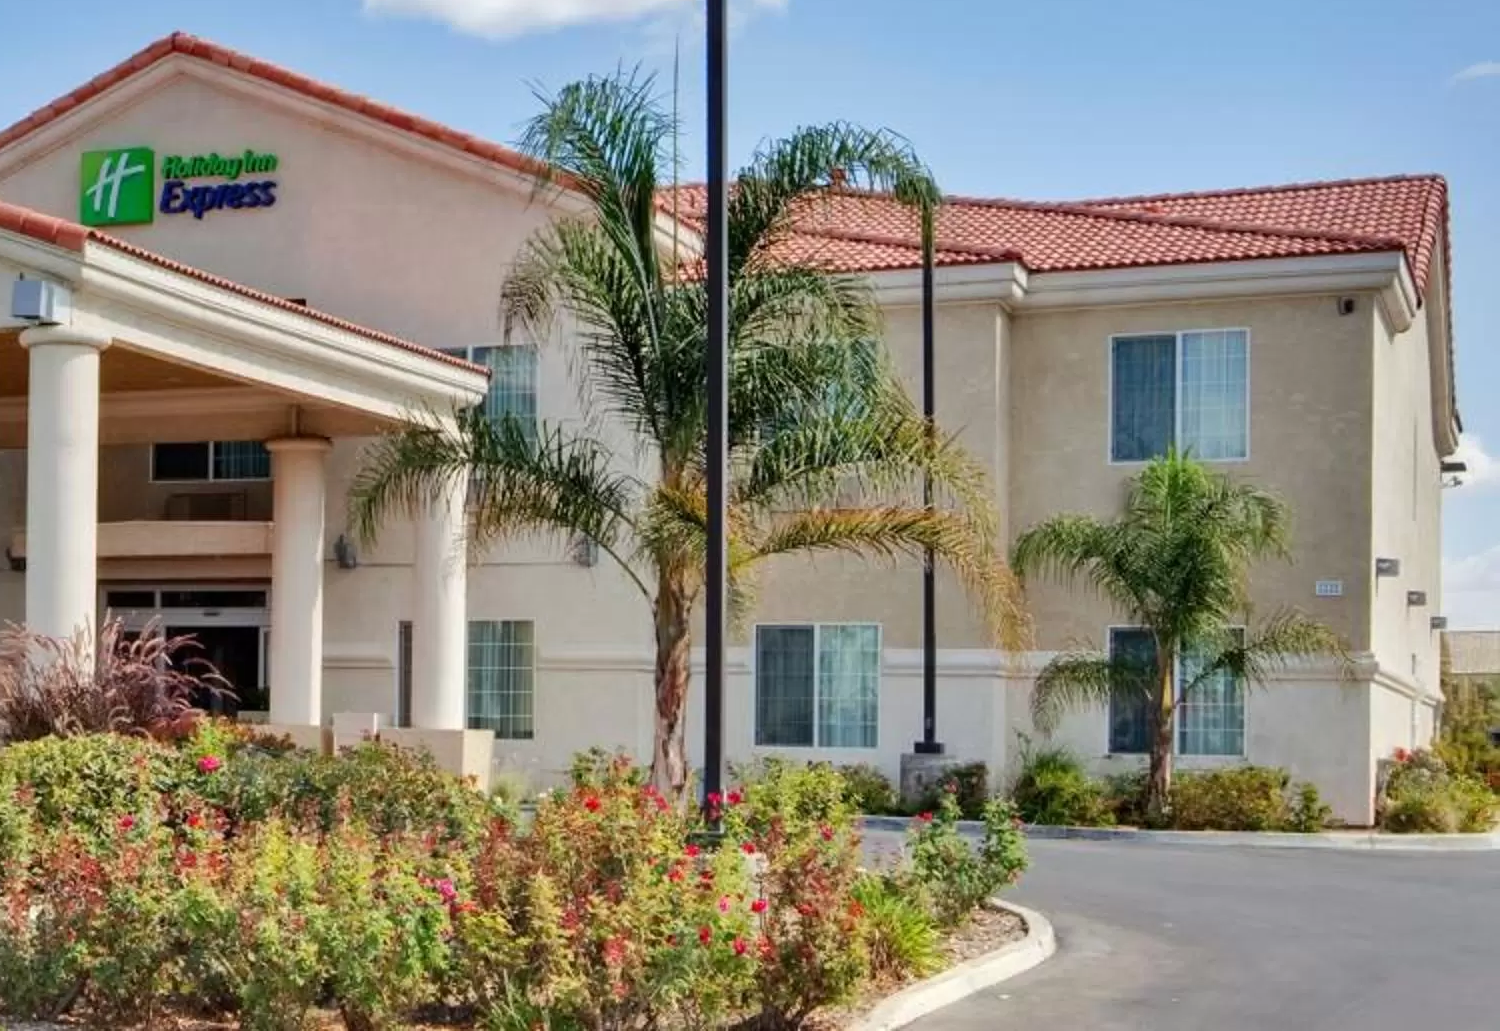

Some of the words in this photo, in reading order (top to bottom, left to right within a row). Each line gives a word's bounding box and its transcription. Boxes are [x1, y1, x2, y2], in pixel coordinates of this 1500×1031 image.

[162, 152, 243, 180] Holiday
[244, 149, 277, 173] Inn
[160, 181, 277, 219] Express
